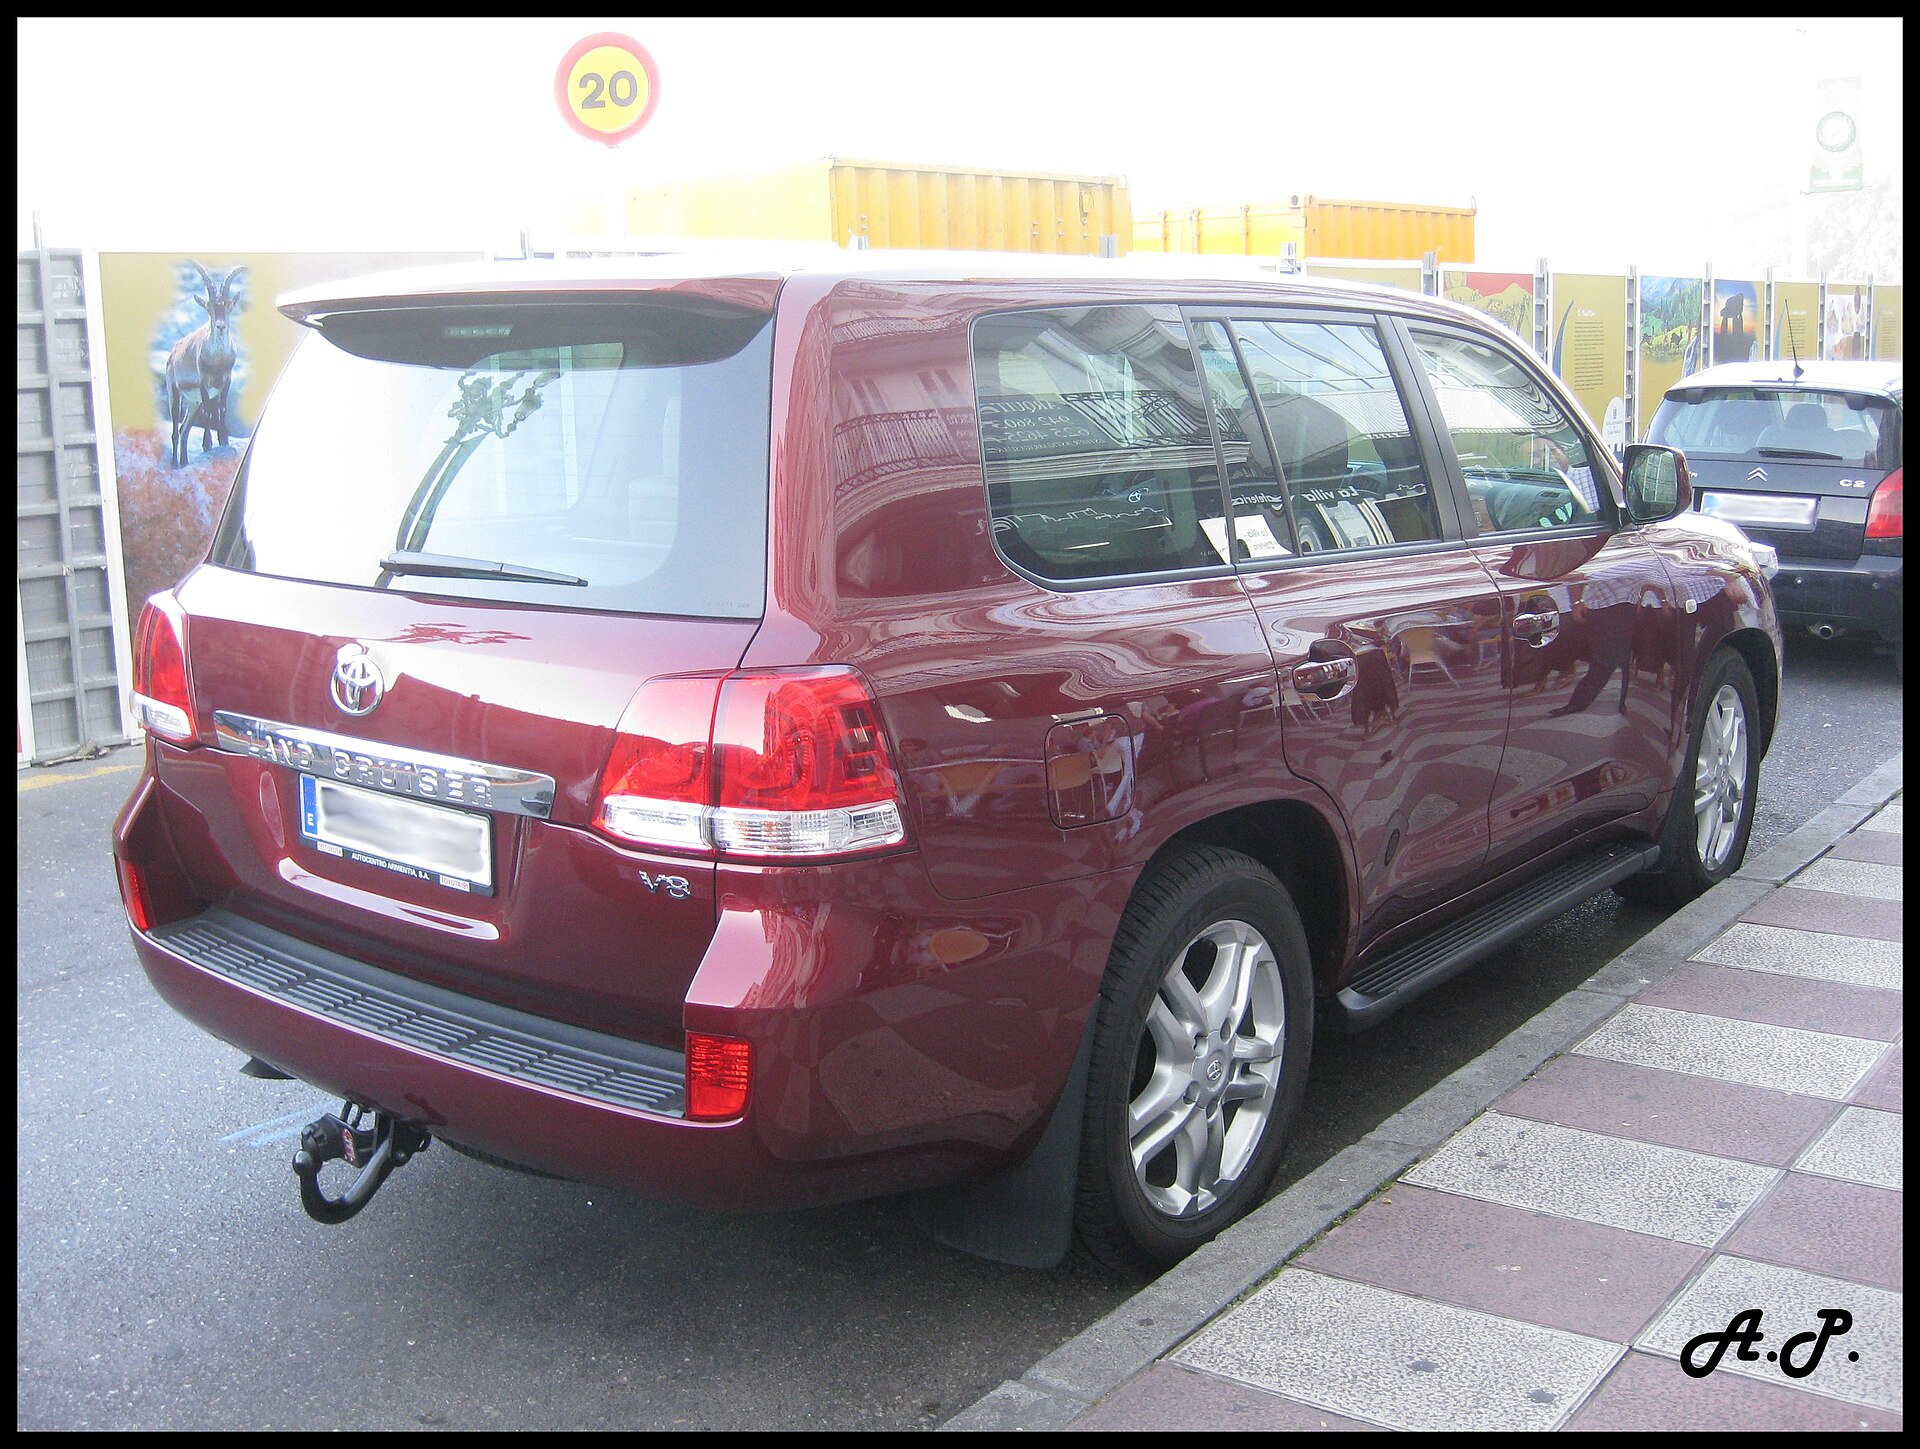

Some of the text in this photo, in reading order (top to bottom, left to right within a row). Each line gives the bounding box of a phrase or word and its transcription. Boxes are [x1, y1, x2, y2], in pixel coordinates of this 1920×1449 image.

[578, 70, 638, 109] 20
[1838, 478, 1867, 488] C2
[246, 730, 494, 808] LAND CRUISER
[307, 812, 315, 827] E
[351, 853, 387, 868] AUTOCENTRO
[418, 870, 431, 881] S.A.
[638, 869, 692, 900] V8
